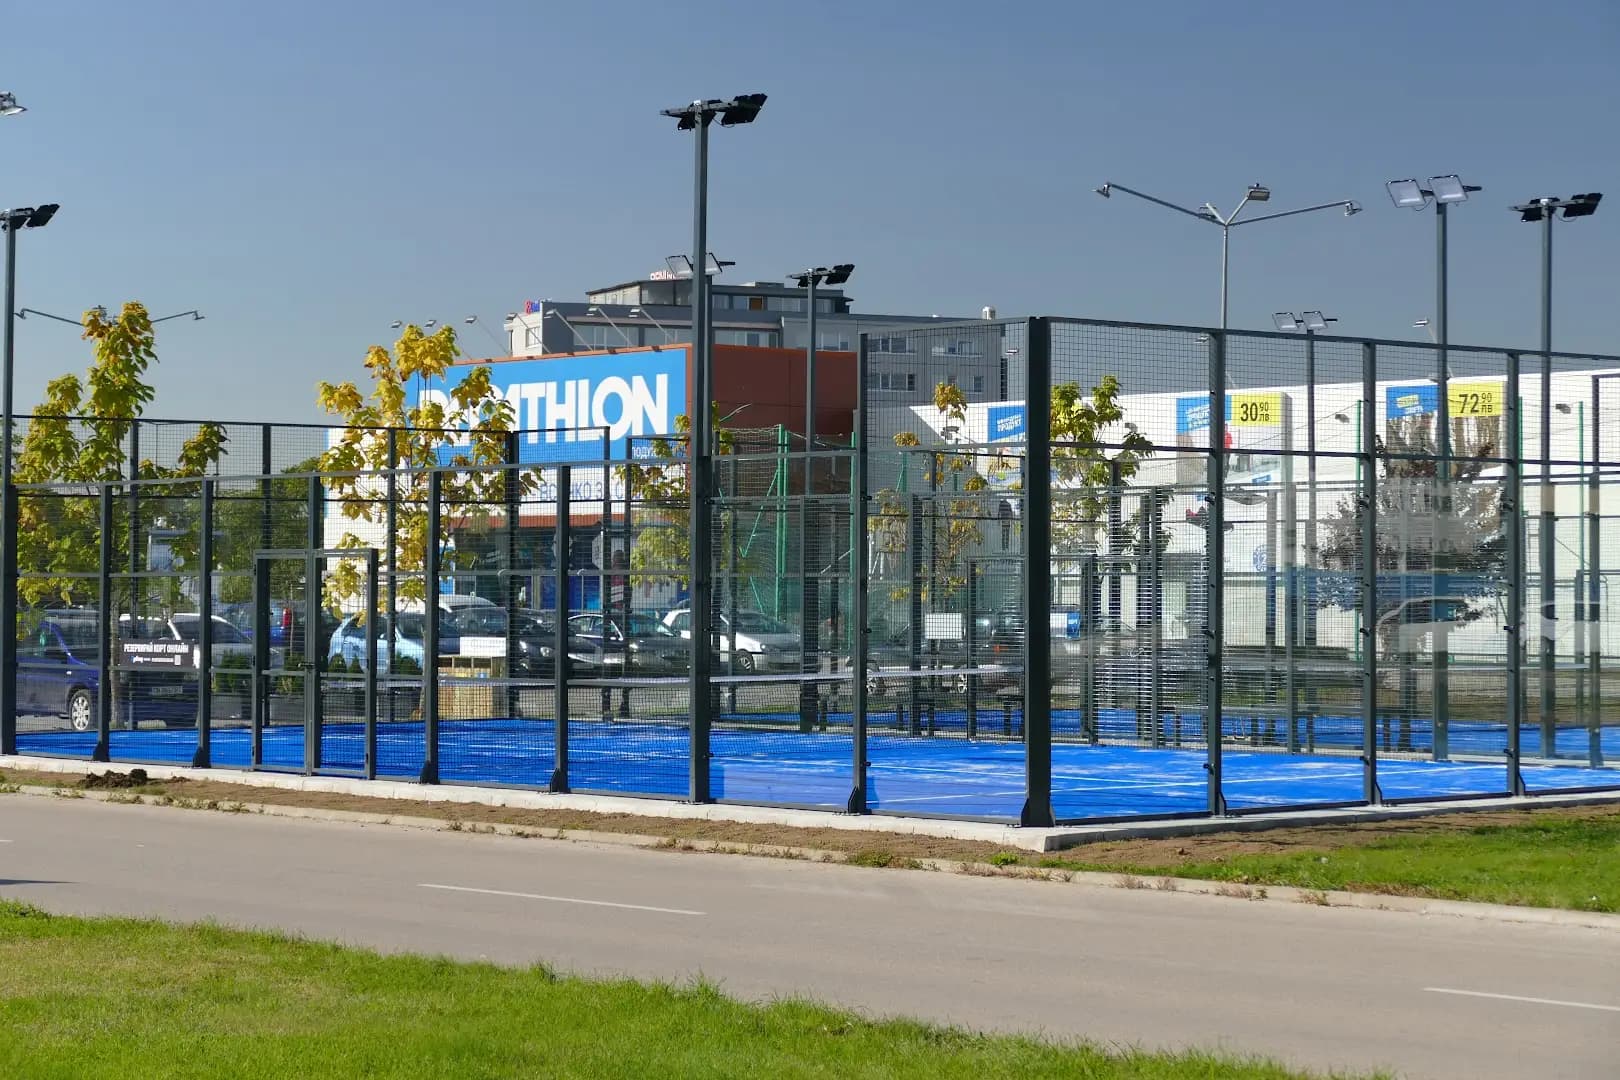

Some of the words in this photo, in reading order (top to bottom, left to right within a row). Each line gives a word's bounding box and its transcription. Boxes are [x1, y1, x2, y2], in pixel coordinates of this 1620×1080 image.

[1240, 402, 1259, 422] 30
[1259, 402, 1269, 412] 90
[1458, 393, 1480, 414] 72
[1481, 392, 1493, 403] 90
[540, 481, 591, 500] ВСКО
